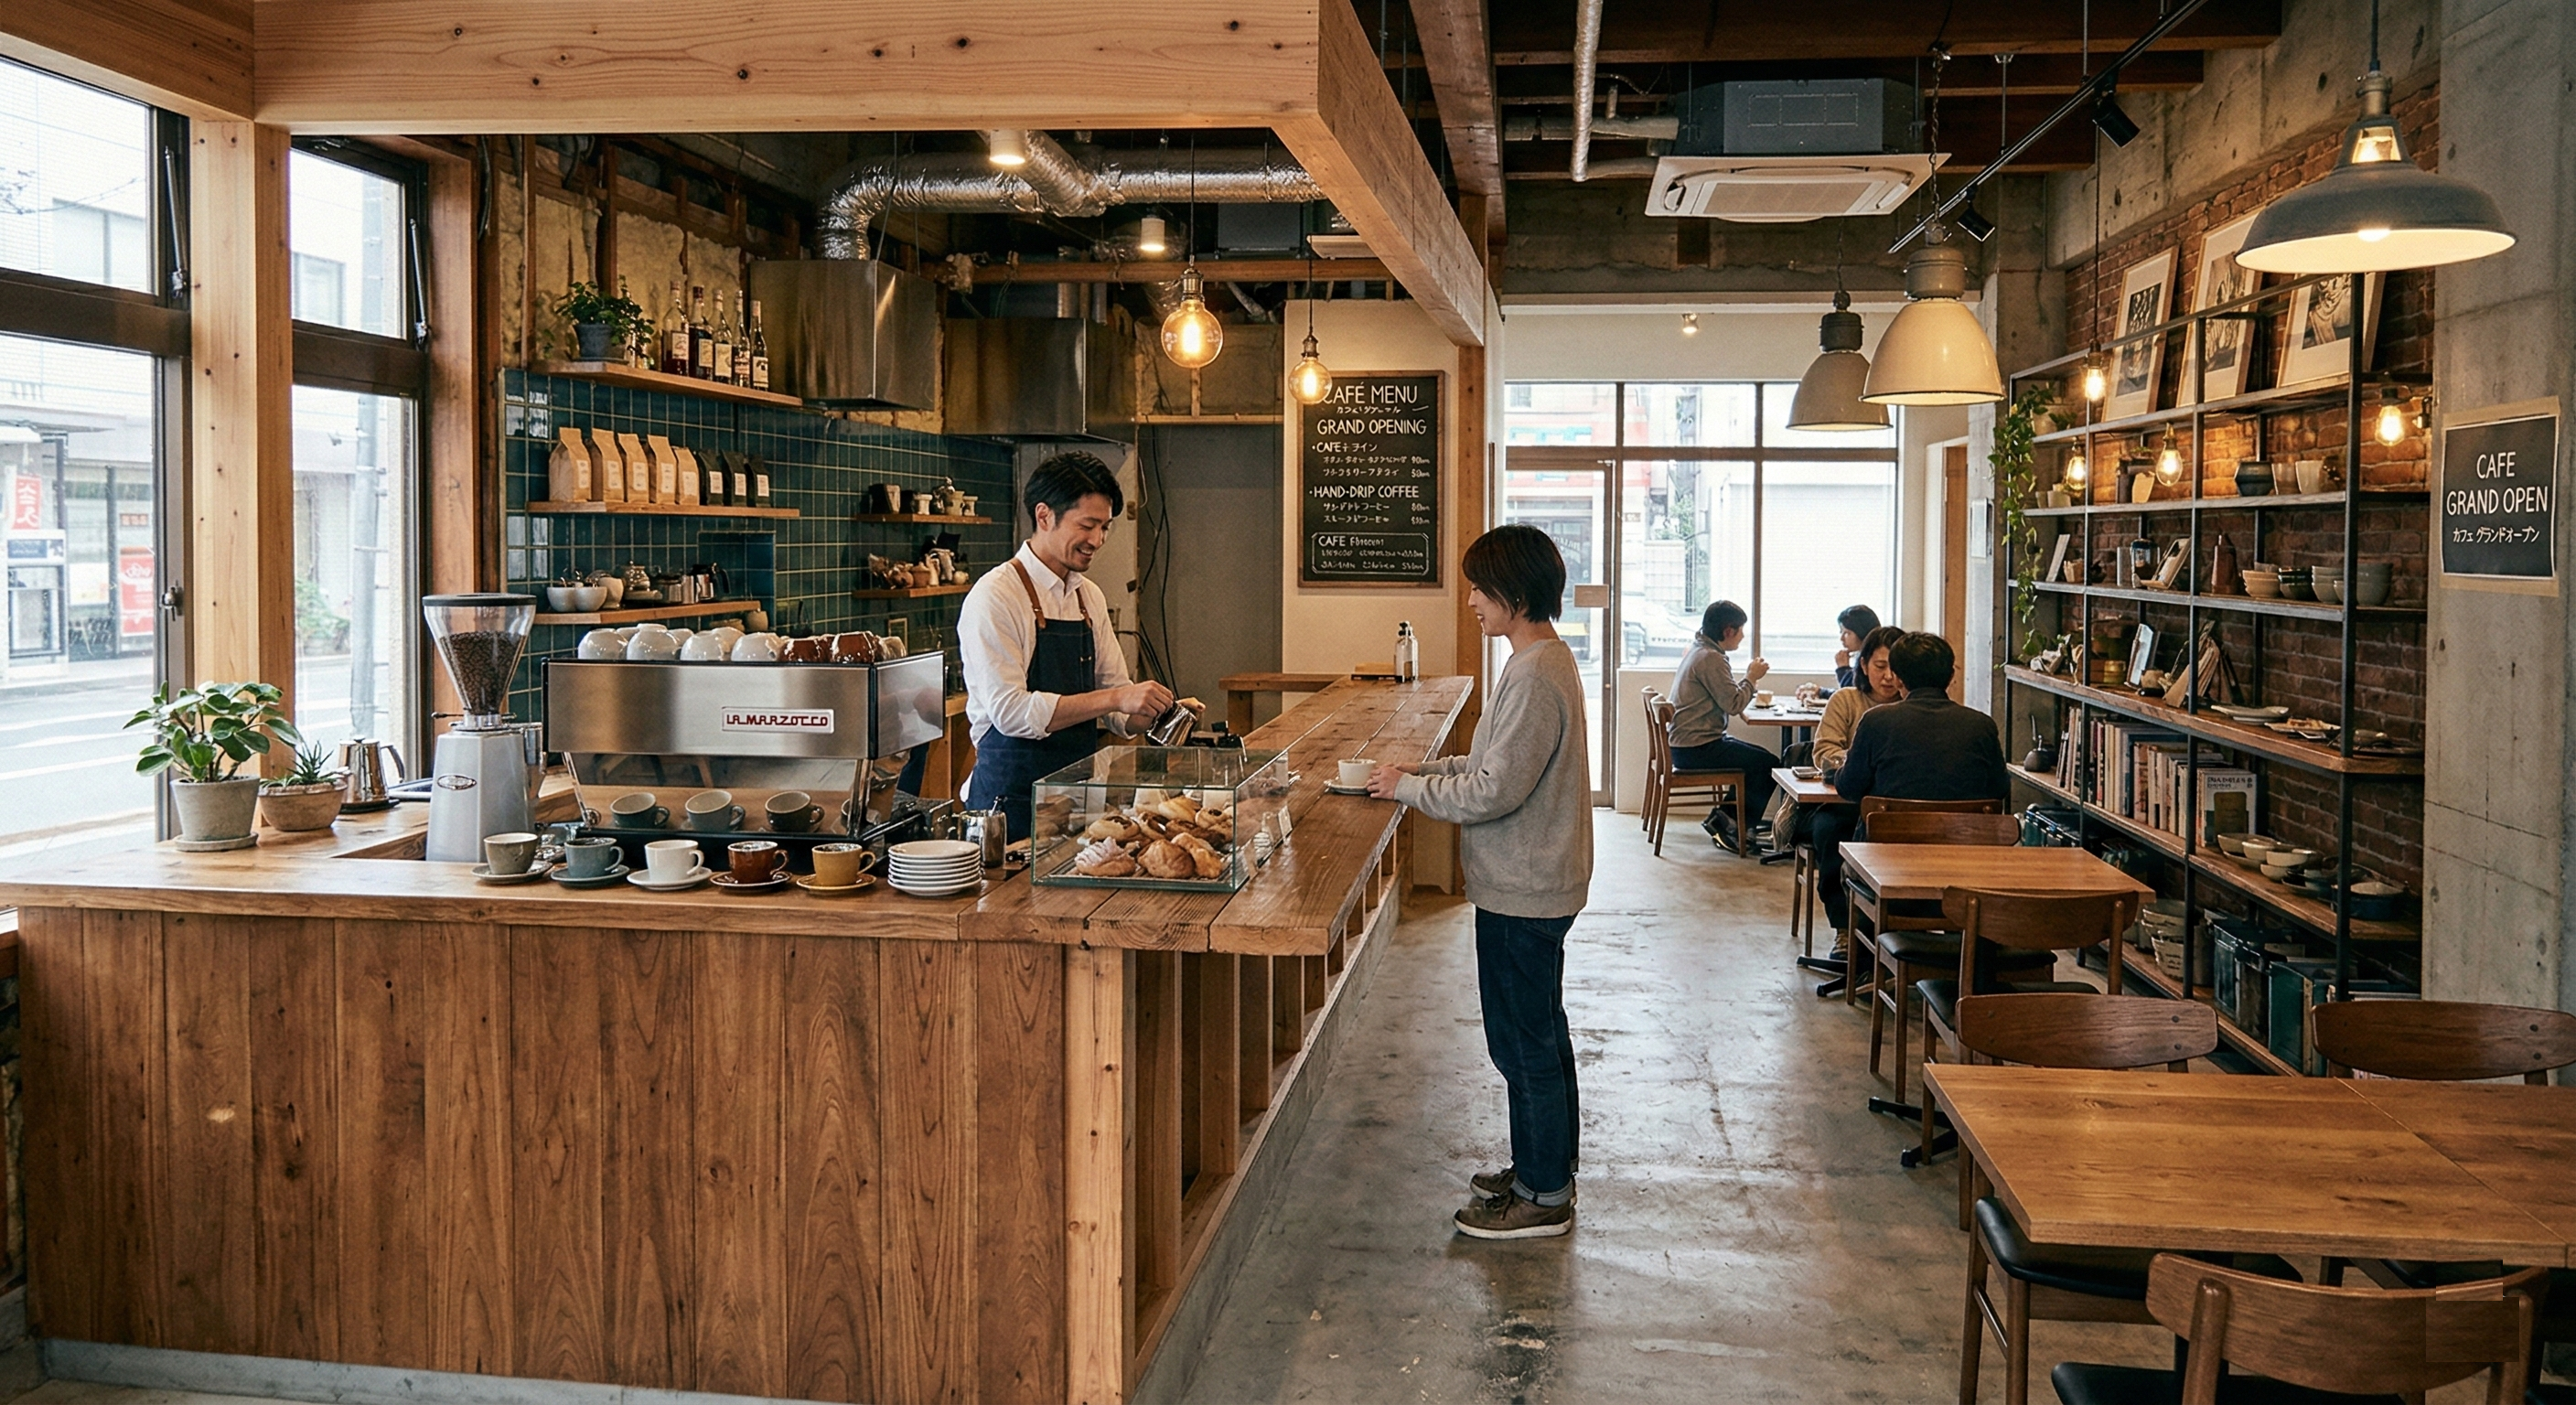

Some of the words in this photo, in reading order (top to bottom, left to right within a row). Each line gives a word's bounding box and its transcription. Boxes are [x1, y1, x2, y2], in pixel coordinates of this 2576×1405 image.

[1370, 385, 1418, 404] MENU
[1317, 419, 1365, 434] GRAND
[1368, 419, 1427, 434] OPENING
[2476, 451, 2517, 479] CAFE
[1378, 485, 1420, 499] COFFEE
[2446, 488, 2499, 516] GRAND
[2503, 486, 2549, 514] OPEN
[1318, 535, 1347, 546] CAFE
[2453, 527, 2474, 542] カフェ
